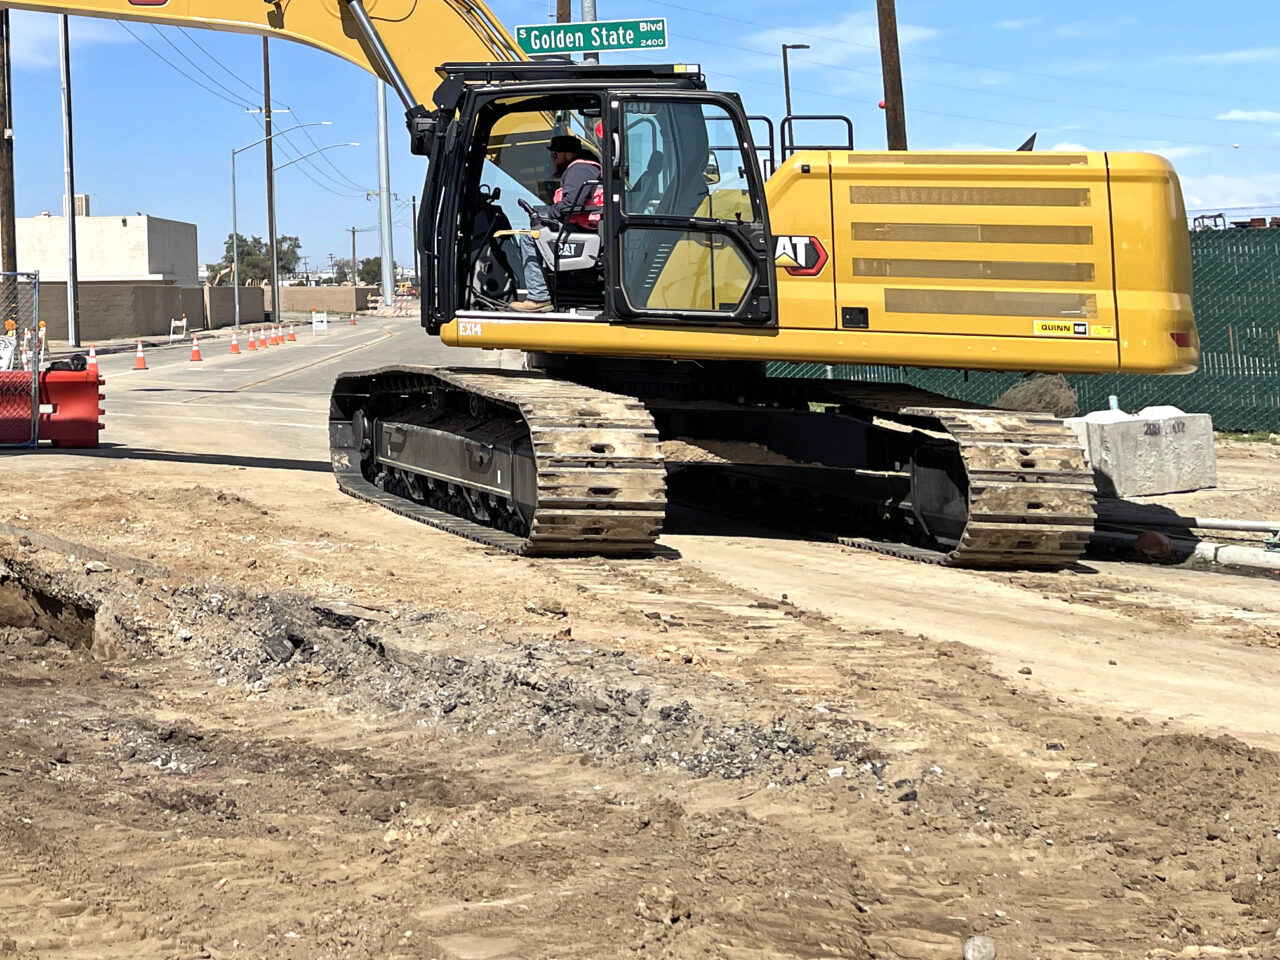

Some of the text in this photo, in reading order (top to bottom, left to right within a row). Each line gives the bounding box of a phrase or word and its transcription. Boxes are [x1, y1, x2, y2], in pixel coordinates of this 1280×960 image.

[519, 22, 663, 50] S Golden State Blvd
[640, 38, 664, 47] 2400
[774, 236, 810, 267] AT
